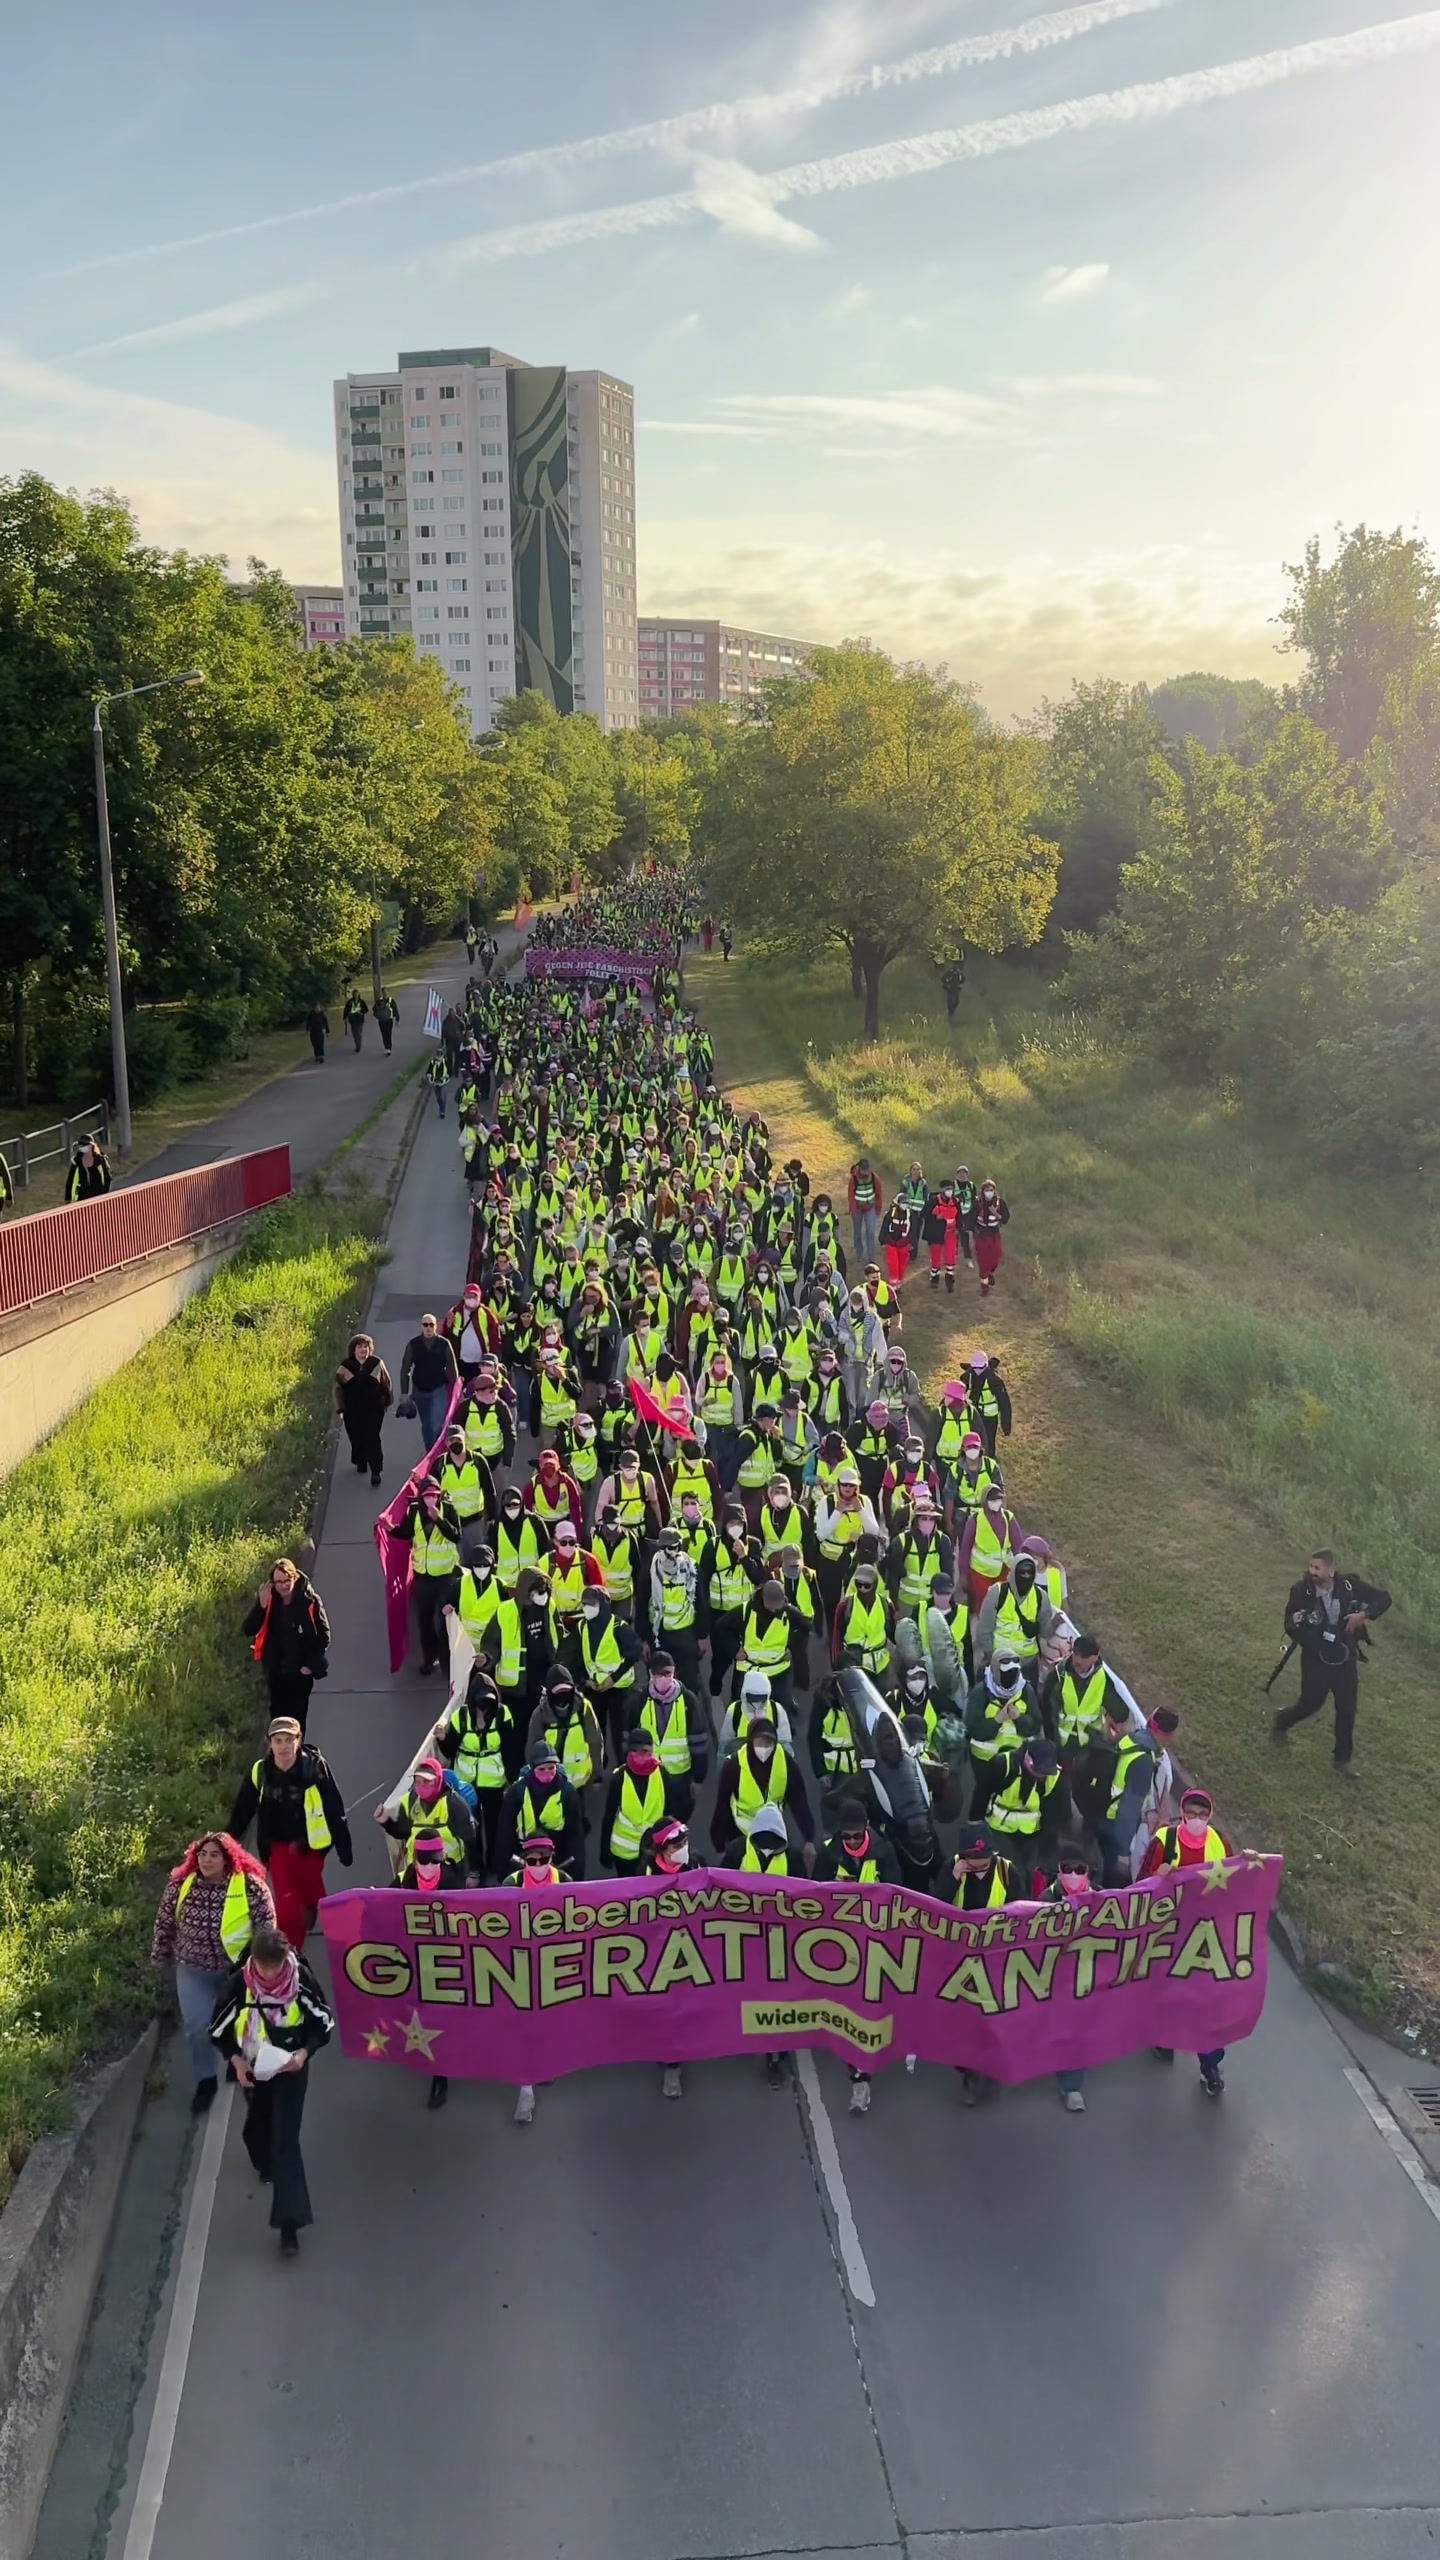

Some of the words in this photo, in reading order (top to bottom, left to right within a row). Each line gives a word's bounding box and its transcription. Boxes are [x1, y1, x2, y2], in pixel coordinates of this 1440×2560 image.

[545, 961, 573, 970] GEGEN
[403, 1899, 511, 1939] Eine
[519, 1884, 823, 1940] lebenswerte
[831, 1893, 1020, 1948] Zukunft
[1027, 1901, 1090, 1940] für
[343, 1918, 924, 2011] GENERATION
[936, 1913, 1255, 2016] ANTIFA!
[755, 2008, 882, 2047] widersetzen
